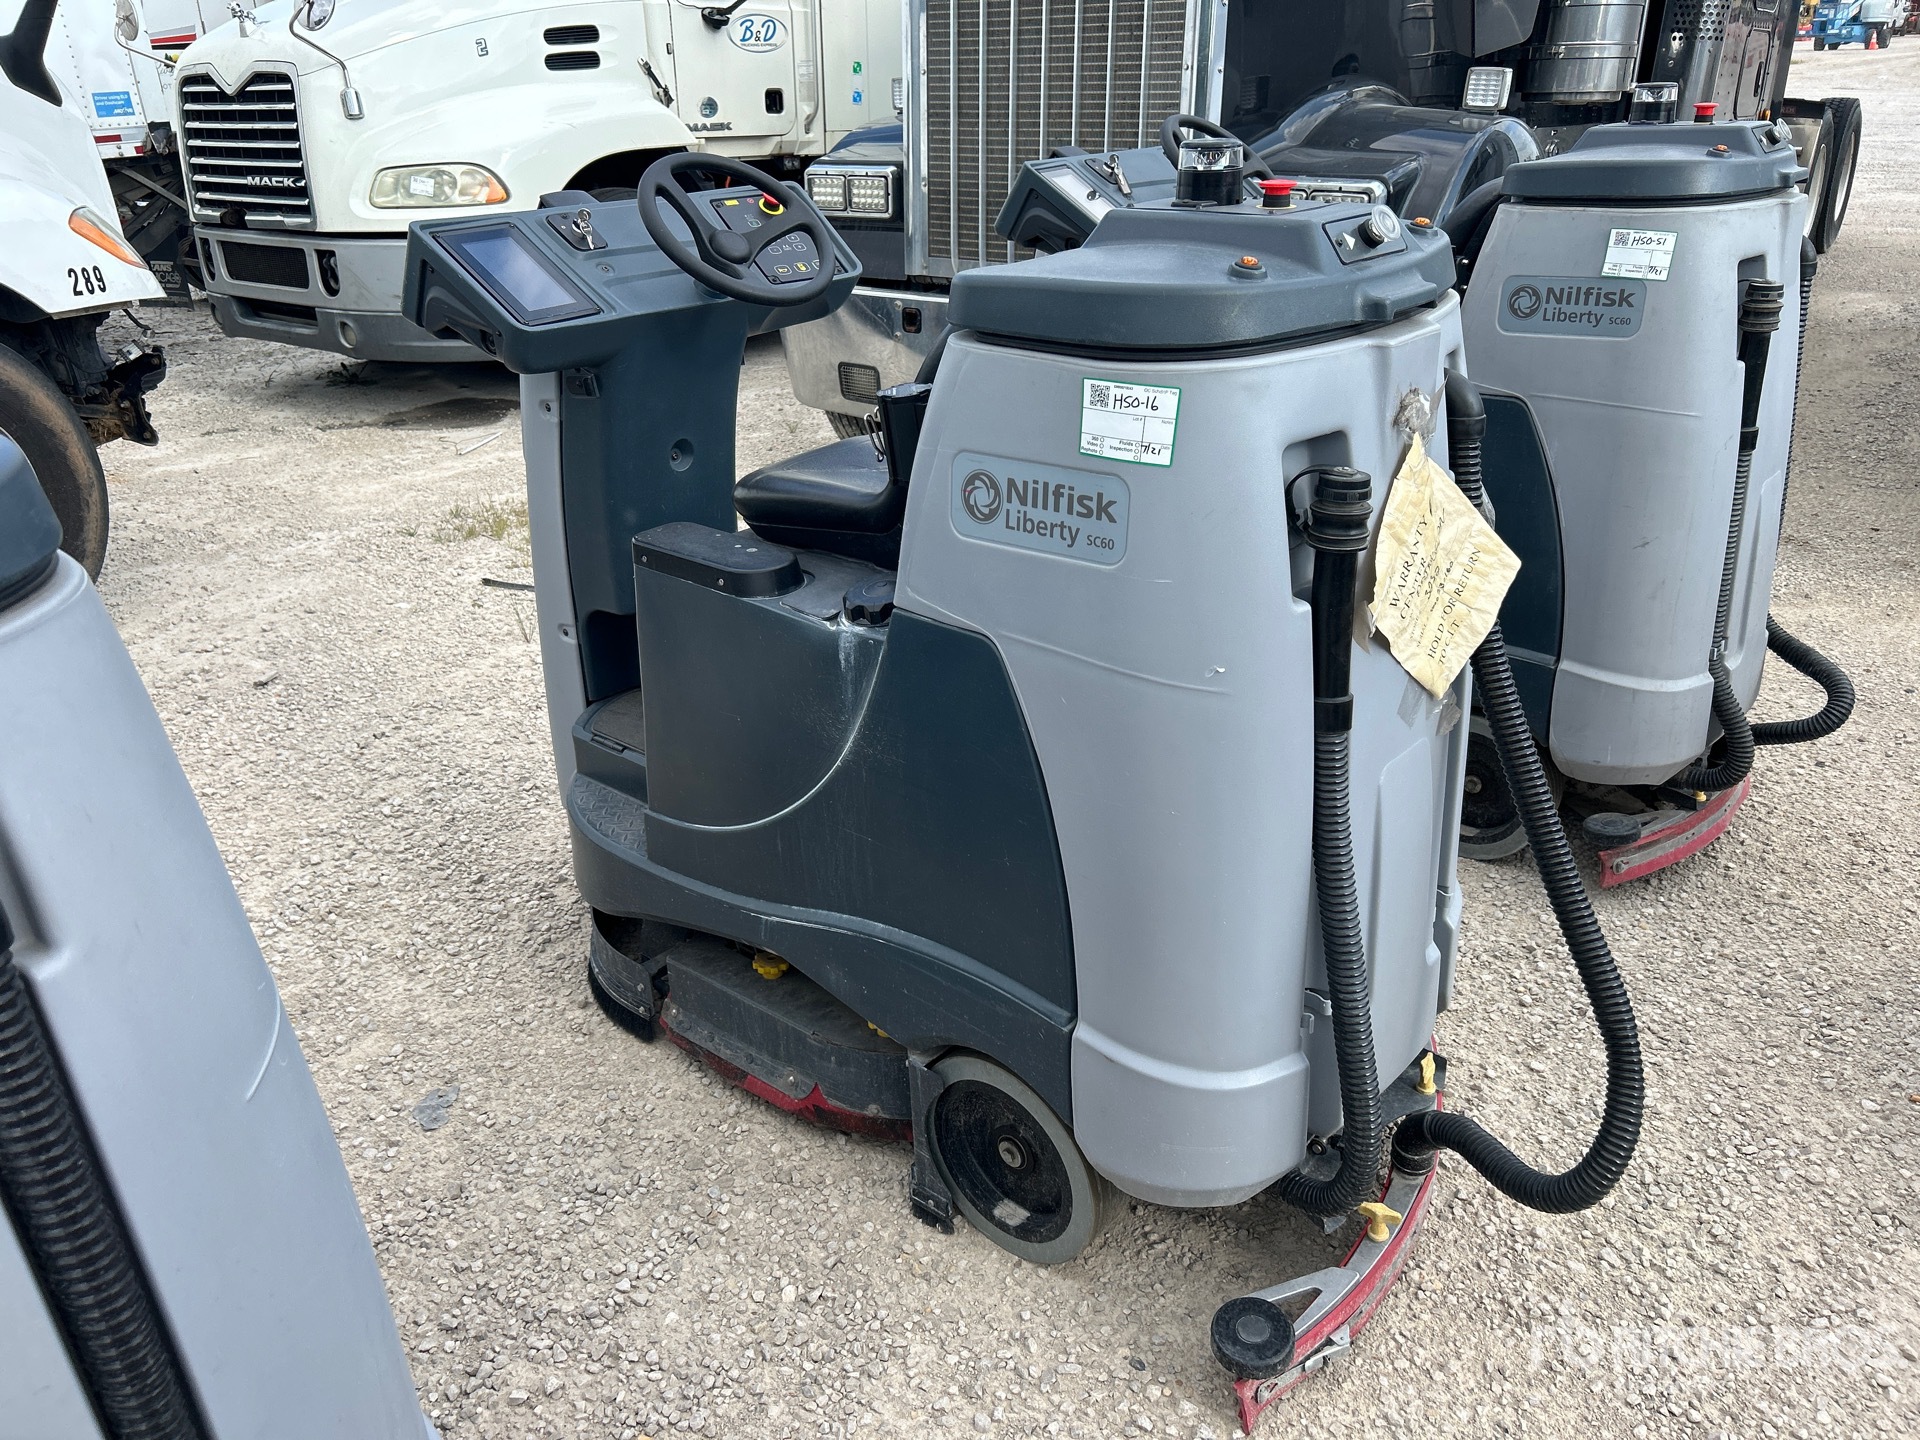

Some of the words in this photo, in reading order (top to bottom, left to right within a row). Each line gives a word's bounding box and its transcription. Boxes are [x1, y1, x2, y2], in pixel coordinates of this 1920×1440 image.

[739, 18, 777, 43] B&D
[475, 37, 489, 57] 2
[685, 121, 733, 132] MACK
[246, 176, 296, 187] MACK
[67, 265, 106, 296] 289
[1545, 286, 1636, 308] Nilfisk
[1542, 307, 1604, 328] Liberty
[1608, 316, 1632, 325] SC60
[1109, 445, 1133, 453] Inspection
[1141, 443, 1162, 456] 7/21
[1006, 477, 1118, 524] Nilfisk
[1005, 508, 1080, 548] Liberty
[1086, 534, 1115, 550] SC60
[1389, 514, 1427, 607] WARRANTY
[1427, 623, 1444, 659] HOLD
[1441, 597, 1457, 621] FOR
[1453, 547, 1481, 597] RETURN
[1438, 648, 1447, 665] TO
